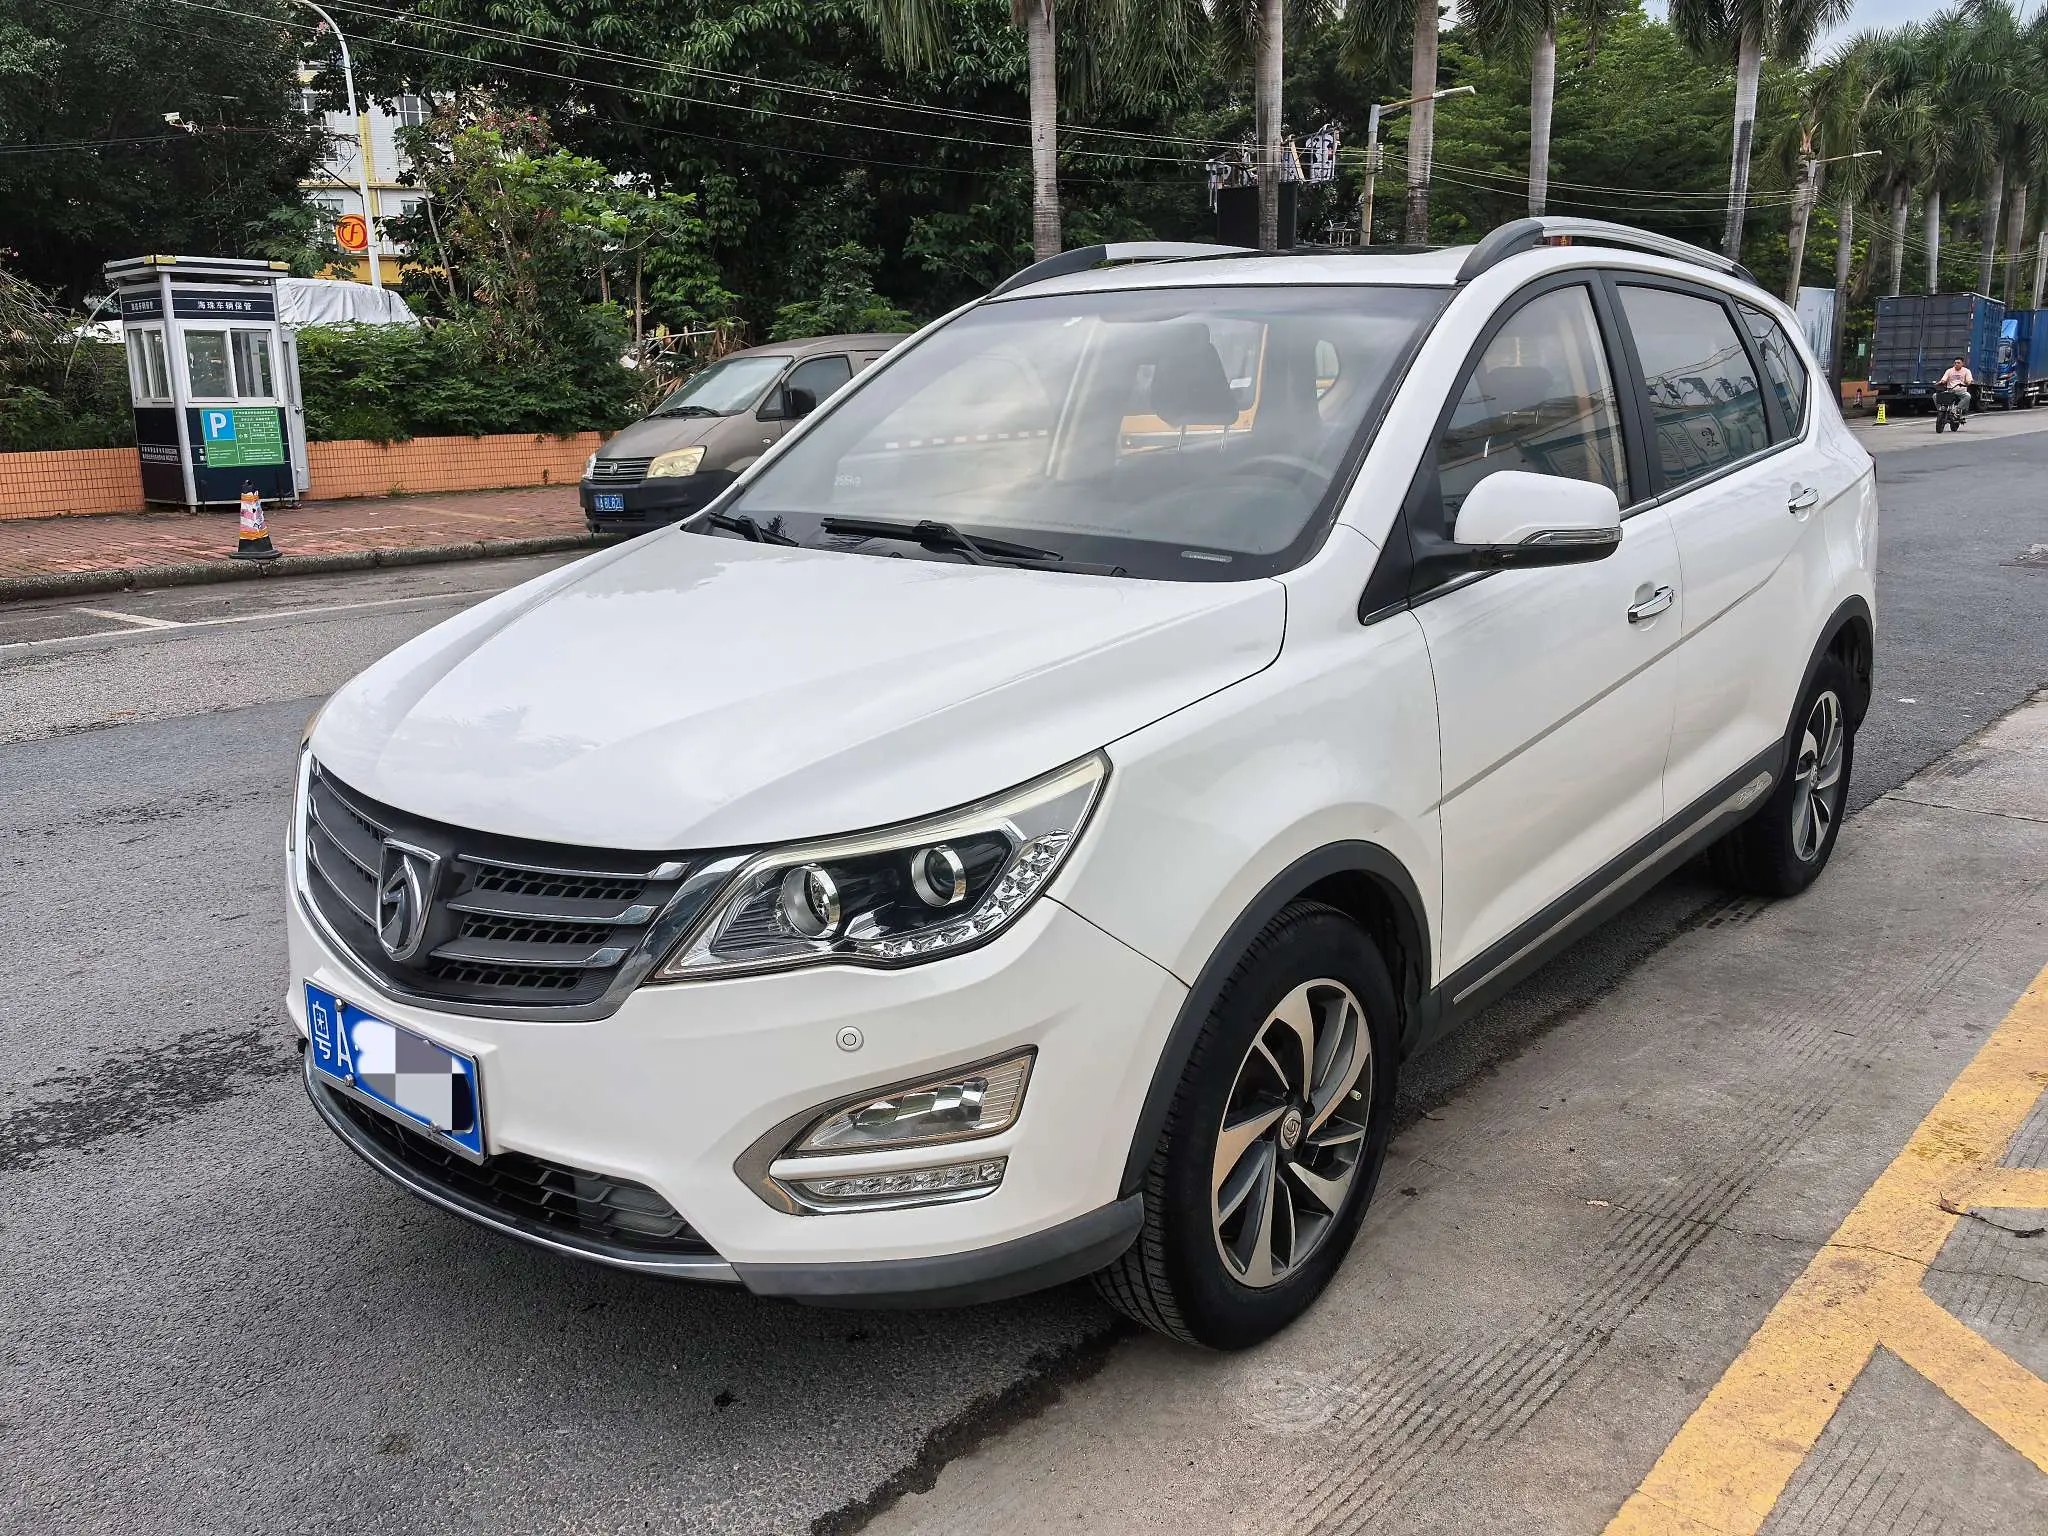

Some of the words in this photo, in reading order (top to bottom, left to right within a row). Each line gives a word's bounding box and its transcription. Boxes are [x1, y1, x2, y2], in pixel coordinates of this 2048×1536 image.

[197, 301, 252, 311] 海珠车辆保管
[209, 412, 227, 438] P
